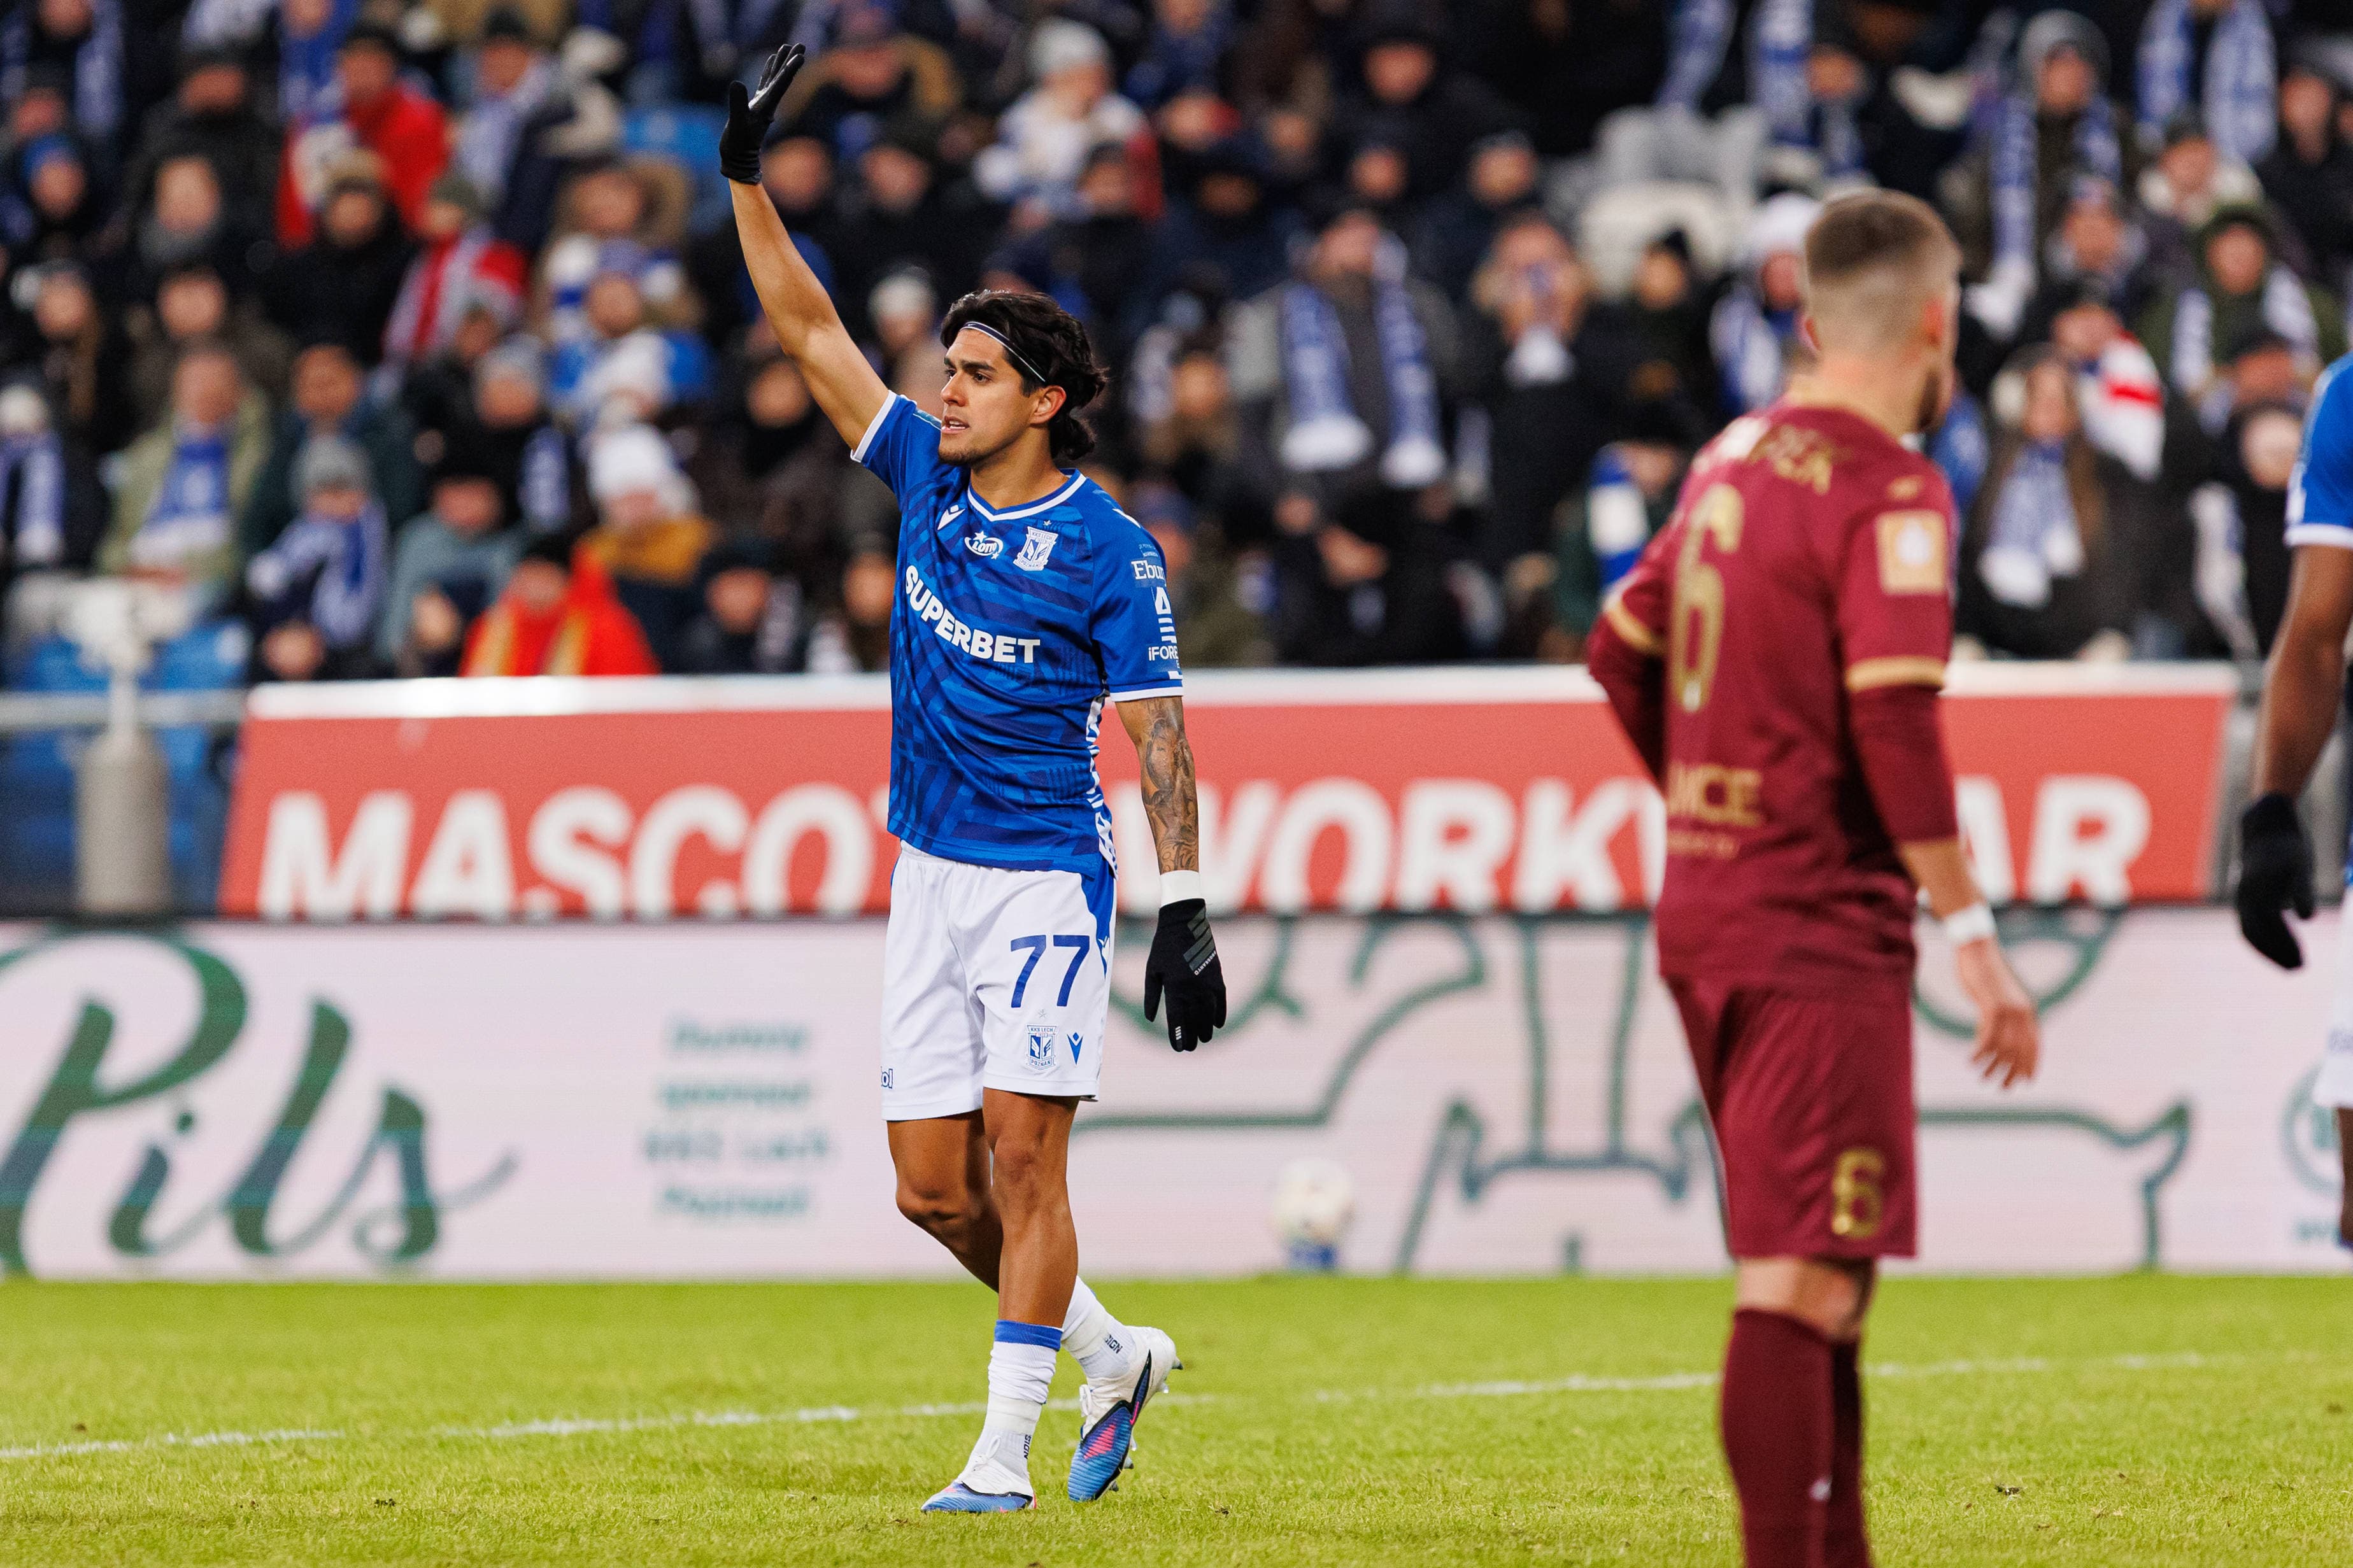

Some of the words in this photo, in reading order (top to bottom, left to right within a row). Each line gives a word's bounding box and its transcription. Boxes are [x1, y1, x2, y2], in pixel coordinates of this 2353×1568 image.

[905, 565, 1041, 664] SUPERBET
[1670, 483, 1745, 714] 6
[258, 783, 889, 920] MASCO
[1011, 935, 1090, 1008] 77
[0, 923, 521, 1281] Pils
[1831, 1148, 1887, 1239] 6
